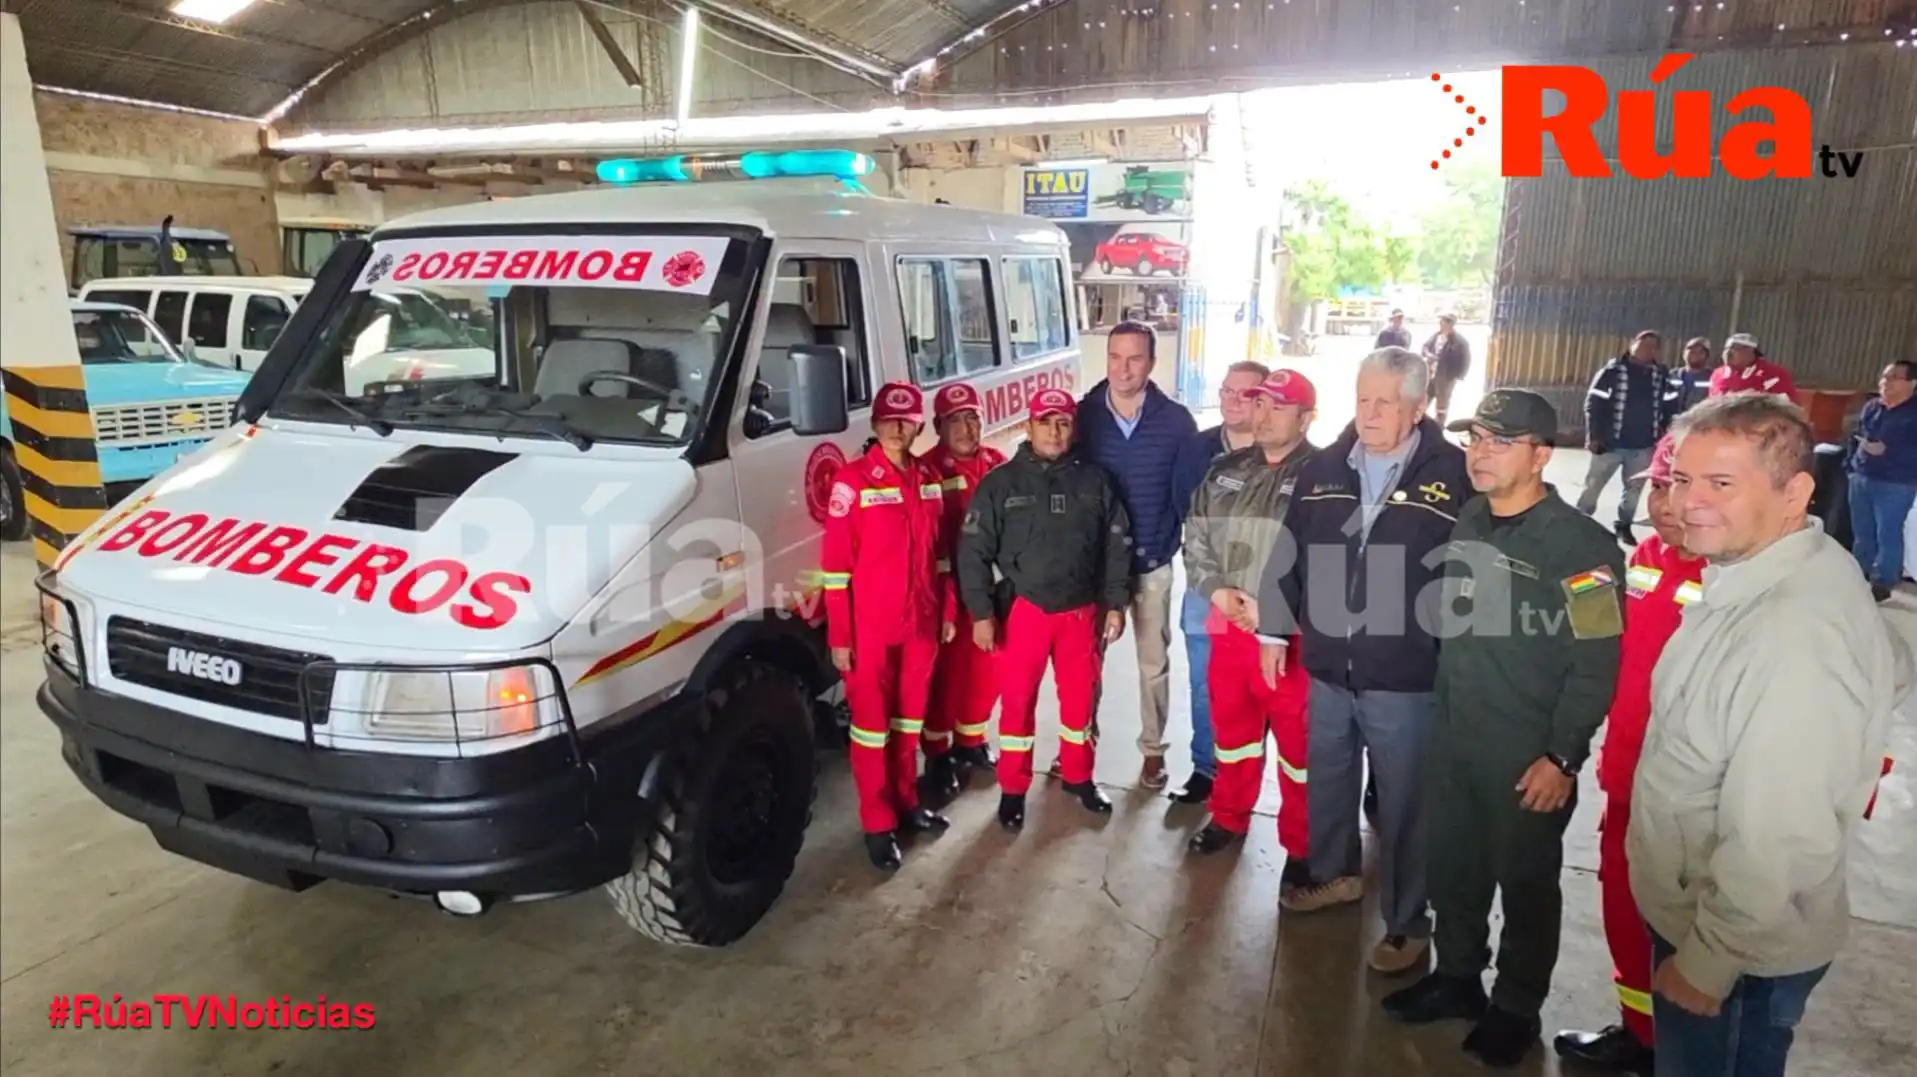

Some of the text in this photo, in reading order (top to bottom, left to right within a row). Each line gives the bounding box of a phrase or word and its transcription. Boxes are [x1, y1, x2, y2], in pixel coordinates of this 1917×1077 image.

[1026, 171, 1086, 194] ITAU
[980, 363, 1075, 425] MBEROS
[96, 510, 531, 630] BOMBEROS
[167, 647, 243, 686] IVECO
